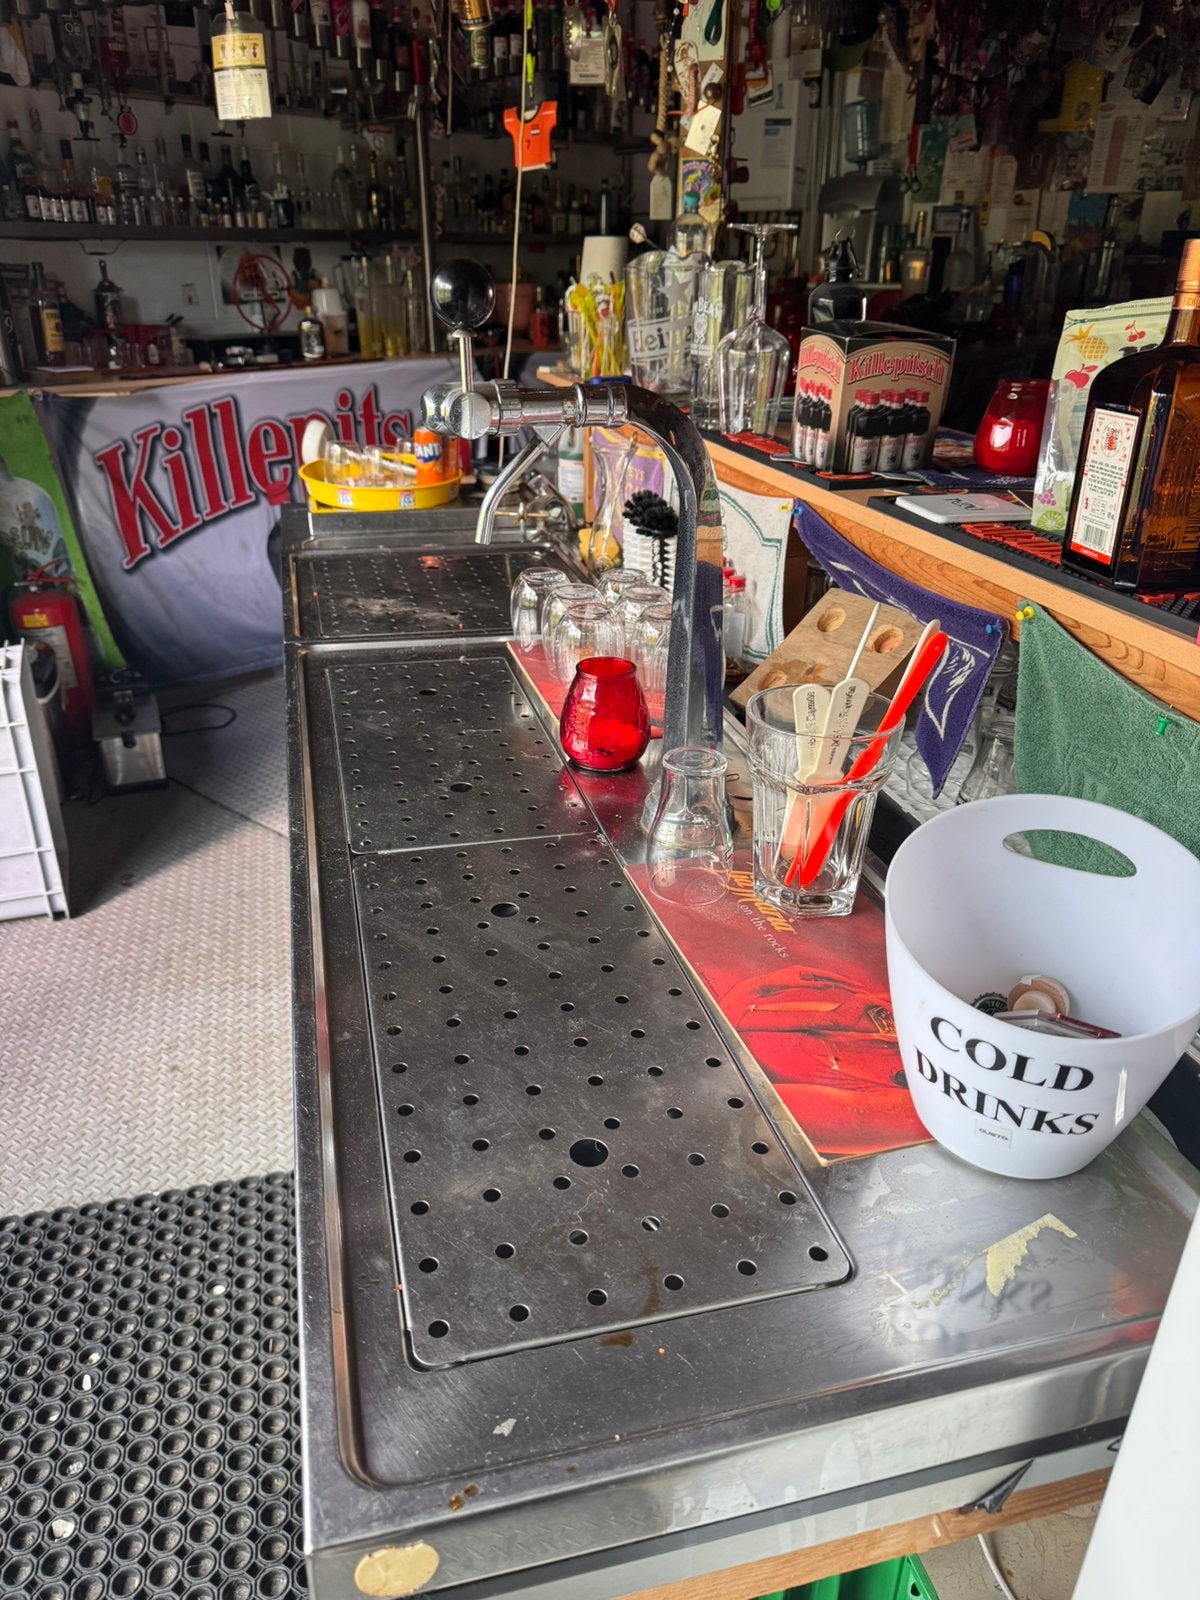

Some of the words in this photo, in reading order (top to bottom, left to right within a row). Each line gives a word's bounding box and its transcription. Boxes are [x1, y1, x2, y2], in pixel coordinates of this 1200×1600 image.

[847, 351, 945, 386] Killepitsch
[96, 384, 413, 570] Killepits
[739, 903, 753, 916] on
[751, 916, 767, 933] the
[763, 932, 790, 959] rocks
[914, 1044, 1101, 1136] DRINKS
[930, 1016, 1095, 1092] COLD
